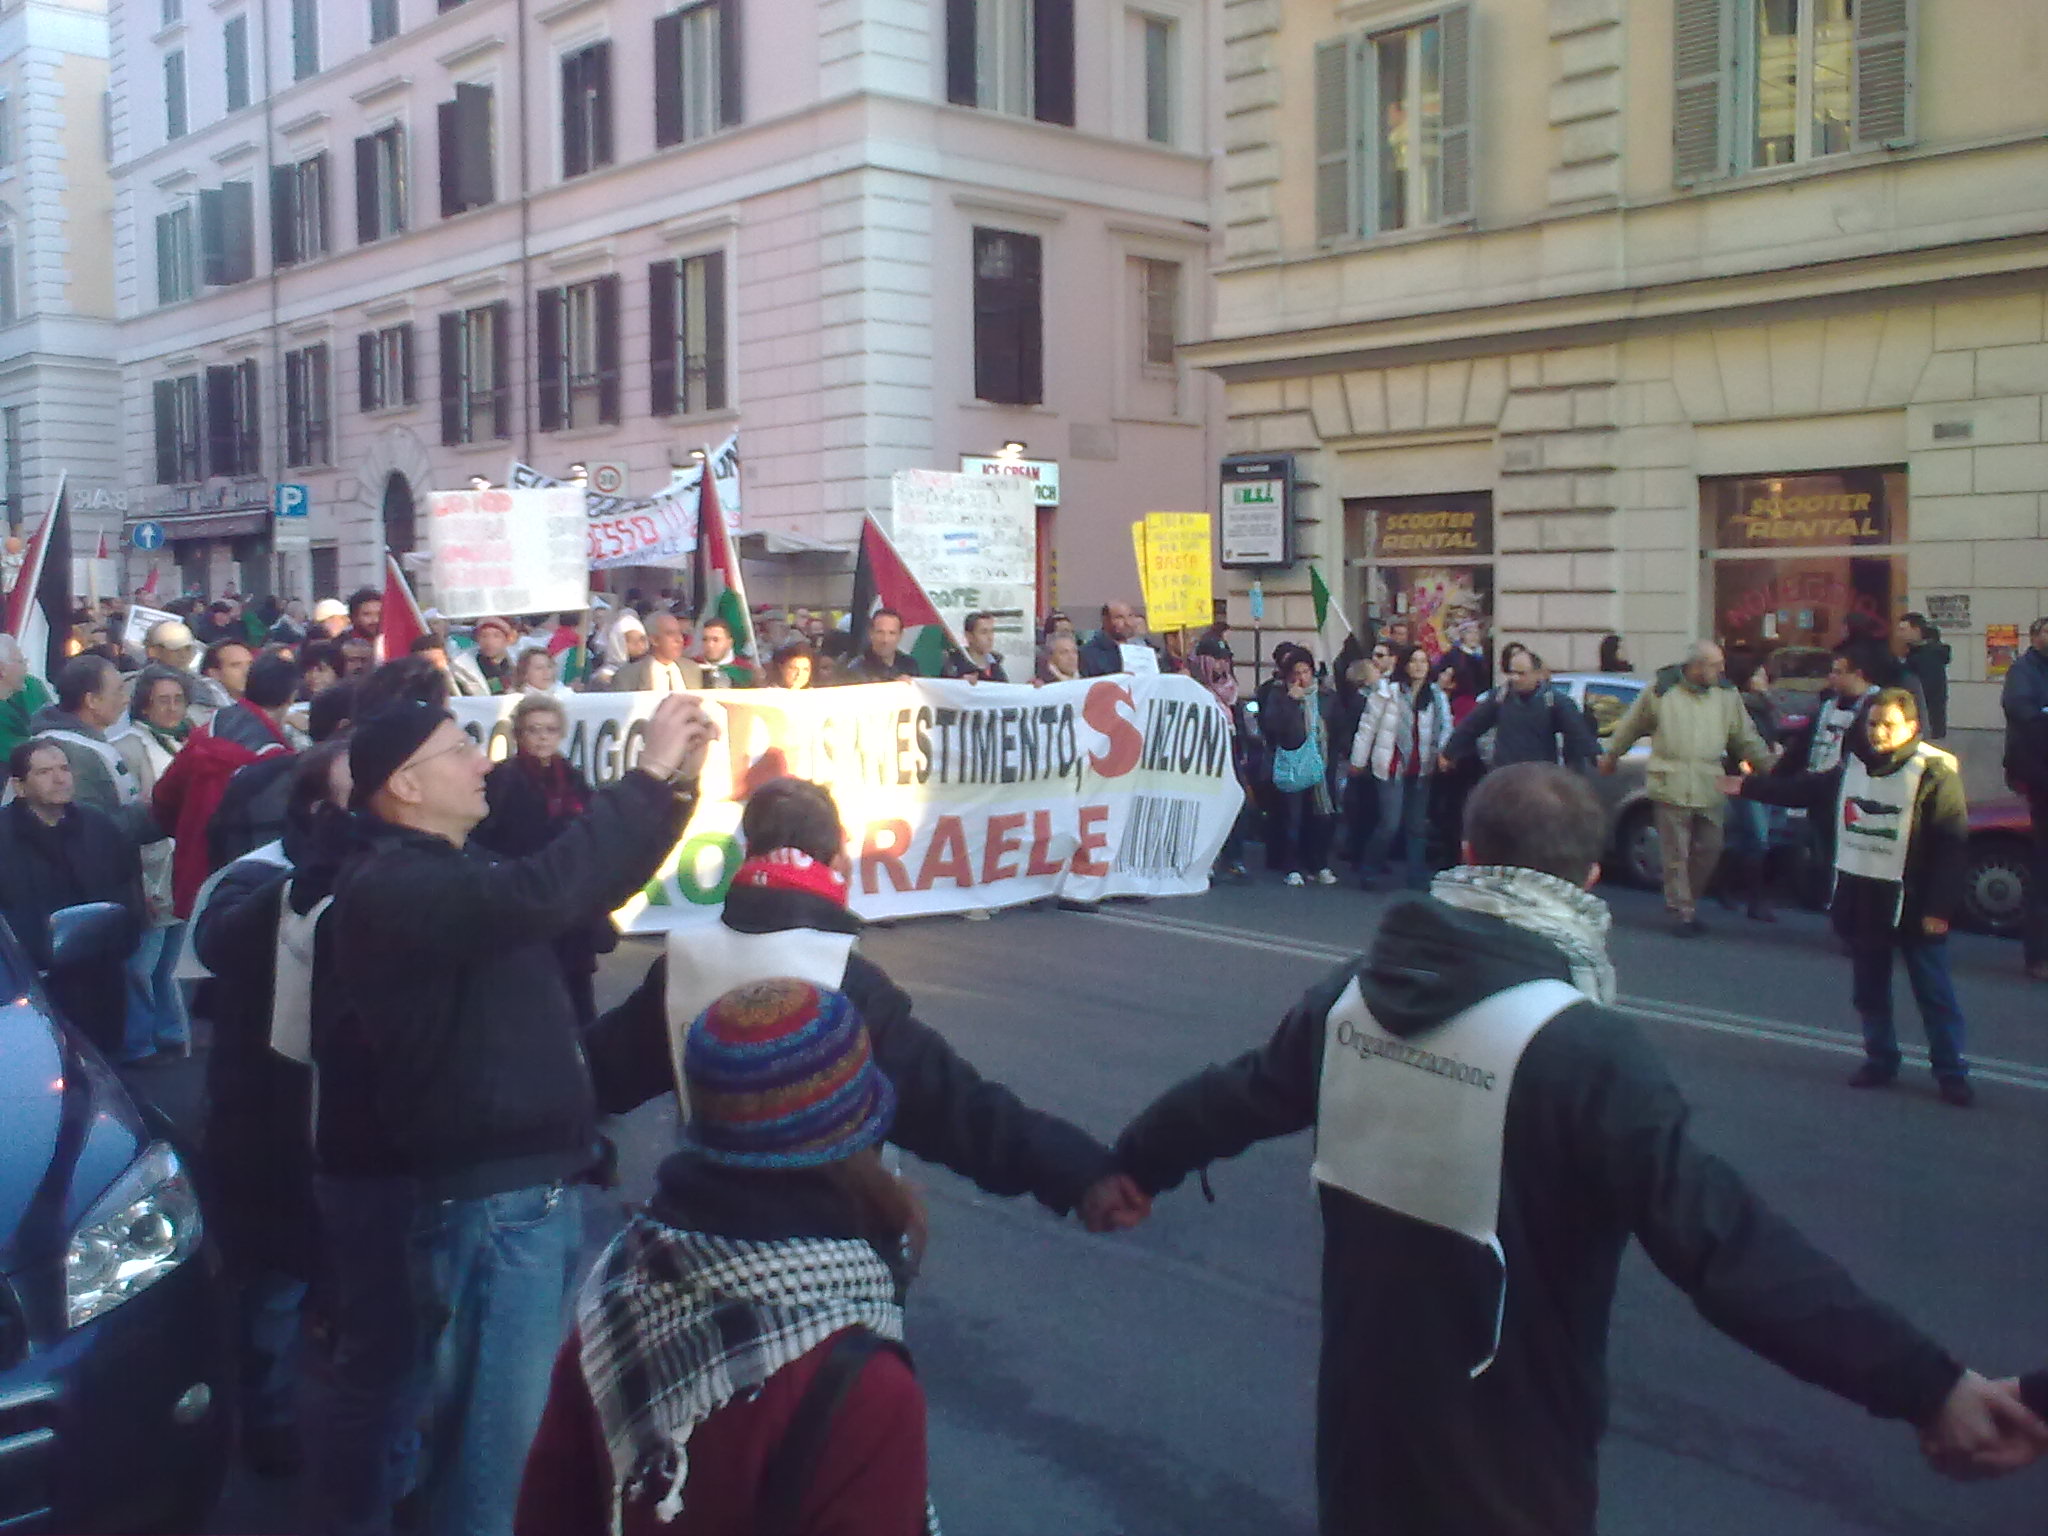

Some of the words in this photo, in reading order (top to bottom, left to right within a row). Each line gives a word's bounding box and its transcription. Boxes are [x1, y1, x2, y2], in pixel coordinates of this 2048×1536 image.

[281, 486, 303, 514] P
[1749, 493, 1873, 517] SCOOTER
[1385, 510, 1475, 531] SCOOTER
[1746, 517, 1880, 539] RENTAL
[1382, 532, 1478, 550] RENTAL
[860, 804, 1110, 895] RAELE
[1337, 1020, 1496, 1091] Organizzazione
